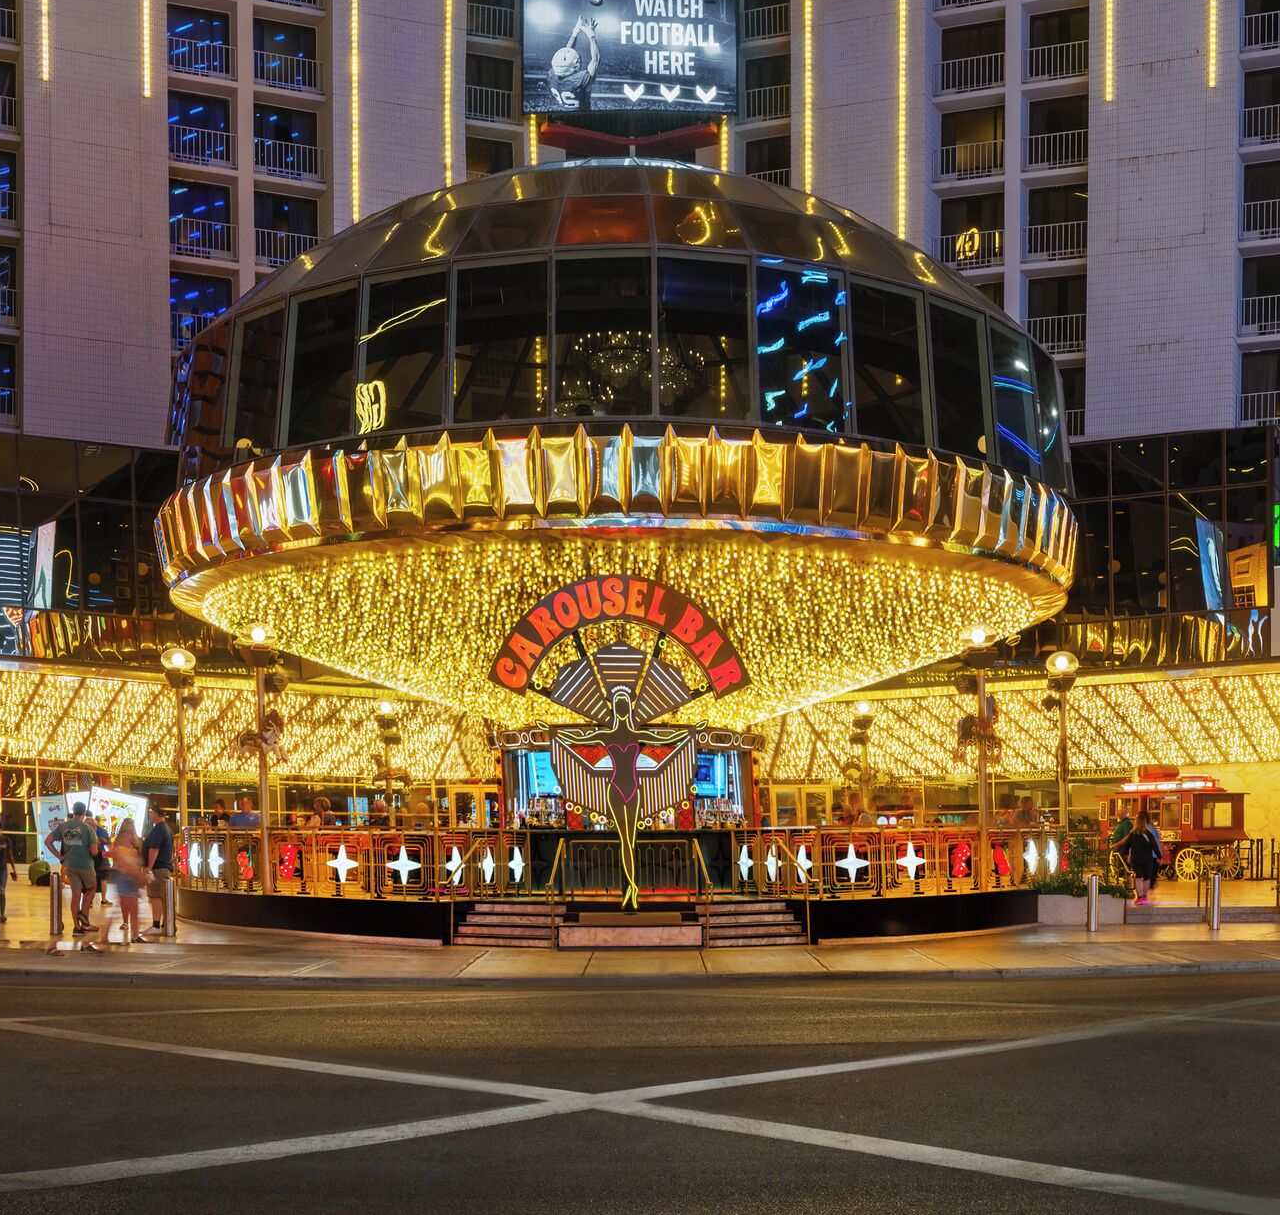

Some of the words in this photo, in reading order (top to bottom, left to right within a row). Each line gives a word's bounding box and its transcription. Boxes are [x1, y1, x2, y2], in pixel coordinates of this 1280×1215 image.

[620, 21, 720, 48] FOOTBALL
[644, 50, 696, 76] HERE
[496, 578, 667, 688] CAROUSEL
[671, 603, 742, 694] BAR
